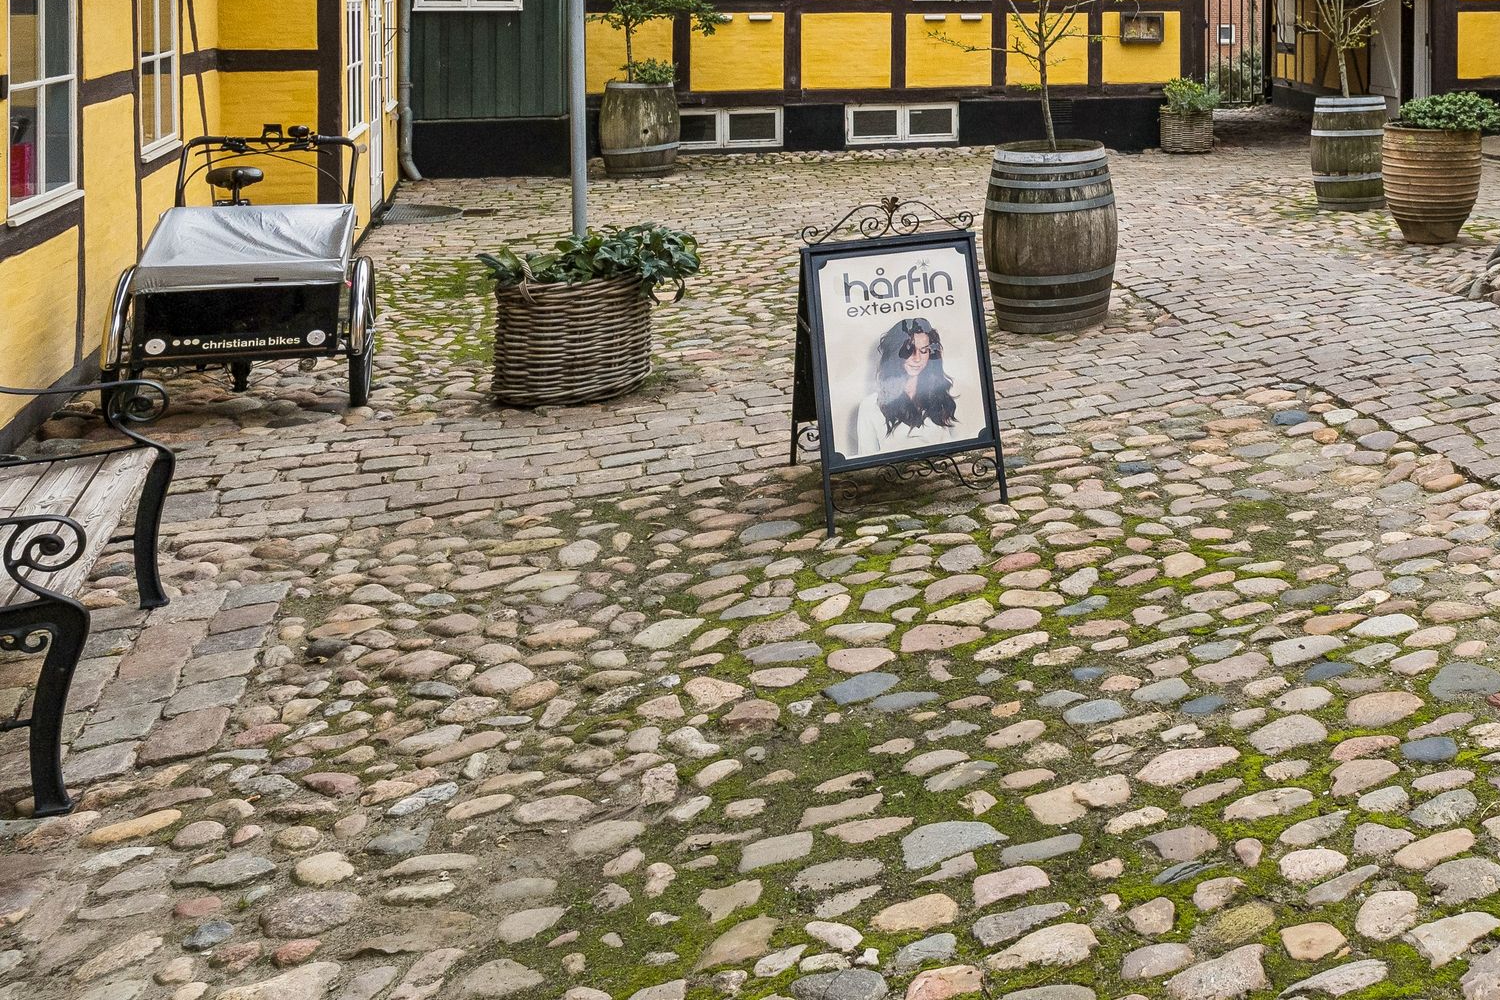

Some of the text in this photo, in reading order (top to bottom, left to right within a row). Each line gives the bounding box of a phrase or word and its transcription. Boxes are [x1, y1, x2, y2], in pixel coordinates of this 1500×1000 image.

[843, 265, 953, 303] hårfin
[846, 294, 955, 317] extensions
[202, 336, 301, 350] christiania bikes
